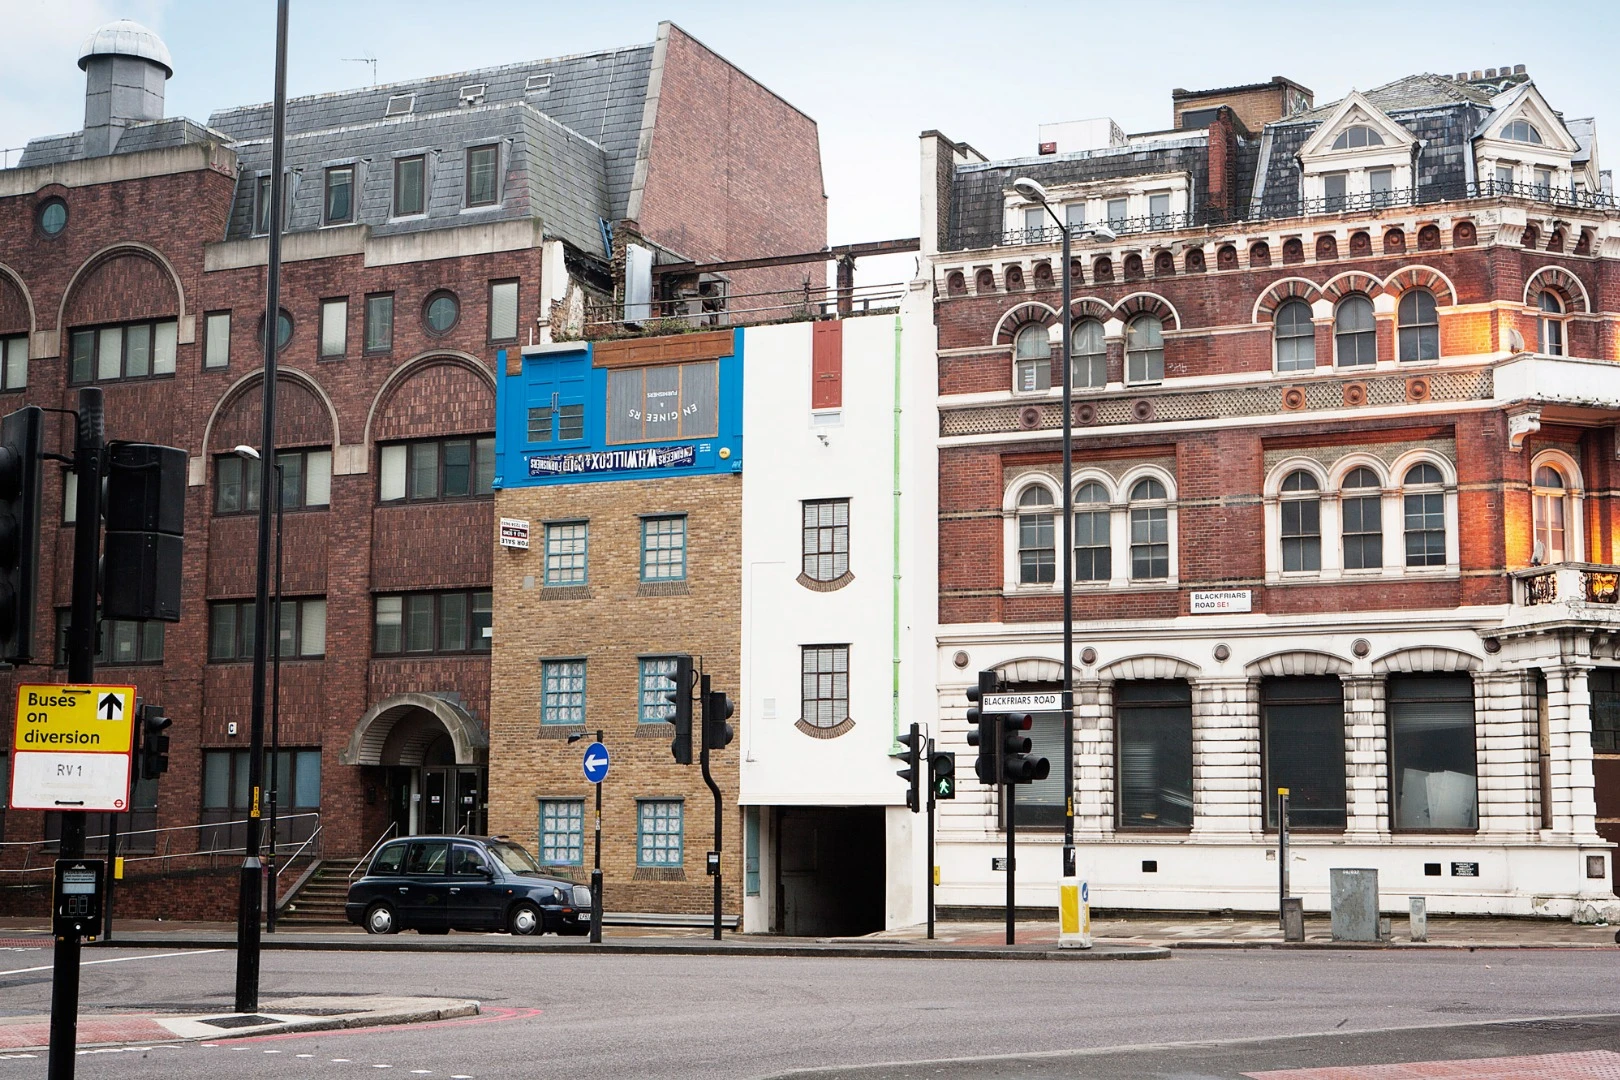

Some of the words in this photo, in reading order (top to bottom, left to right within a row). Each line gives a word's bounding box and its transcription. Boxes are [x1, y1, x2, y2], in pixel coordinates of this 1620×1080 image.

[658, 446, 694, 465] ENGINEERS
[500, 537, 516, 545] SALE
[1194, 592, 1247, 600] BLACKFRIARS
[1194, 601, 1216, 609] ROAD
[28, 692, 77, 707] Buses
[984, 696, 1032, 707] BLACKFRIARS
[1033, 695, 1056, 705] ROAD
[26, 712, 48, 724] on
[24, 729, 101, 745] diversion
